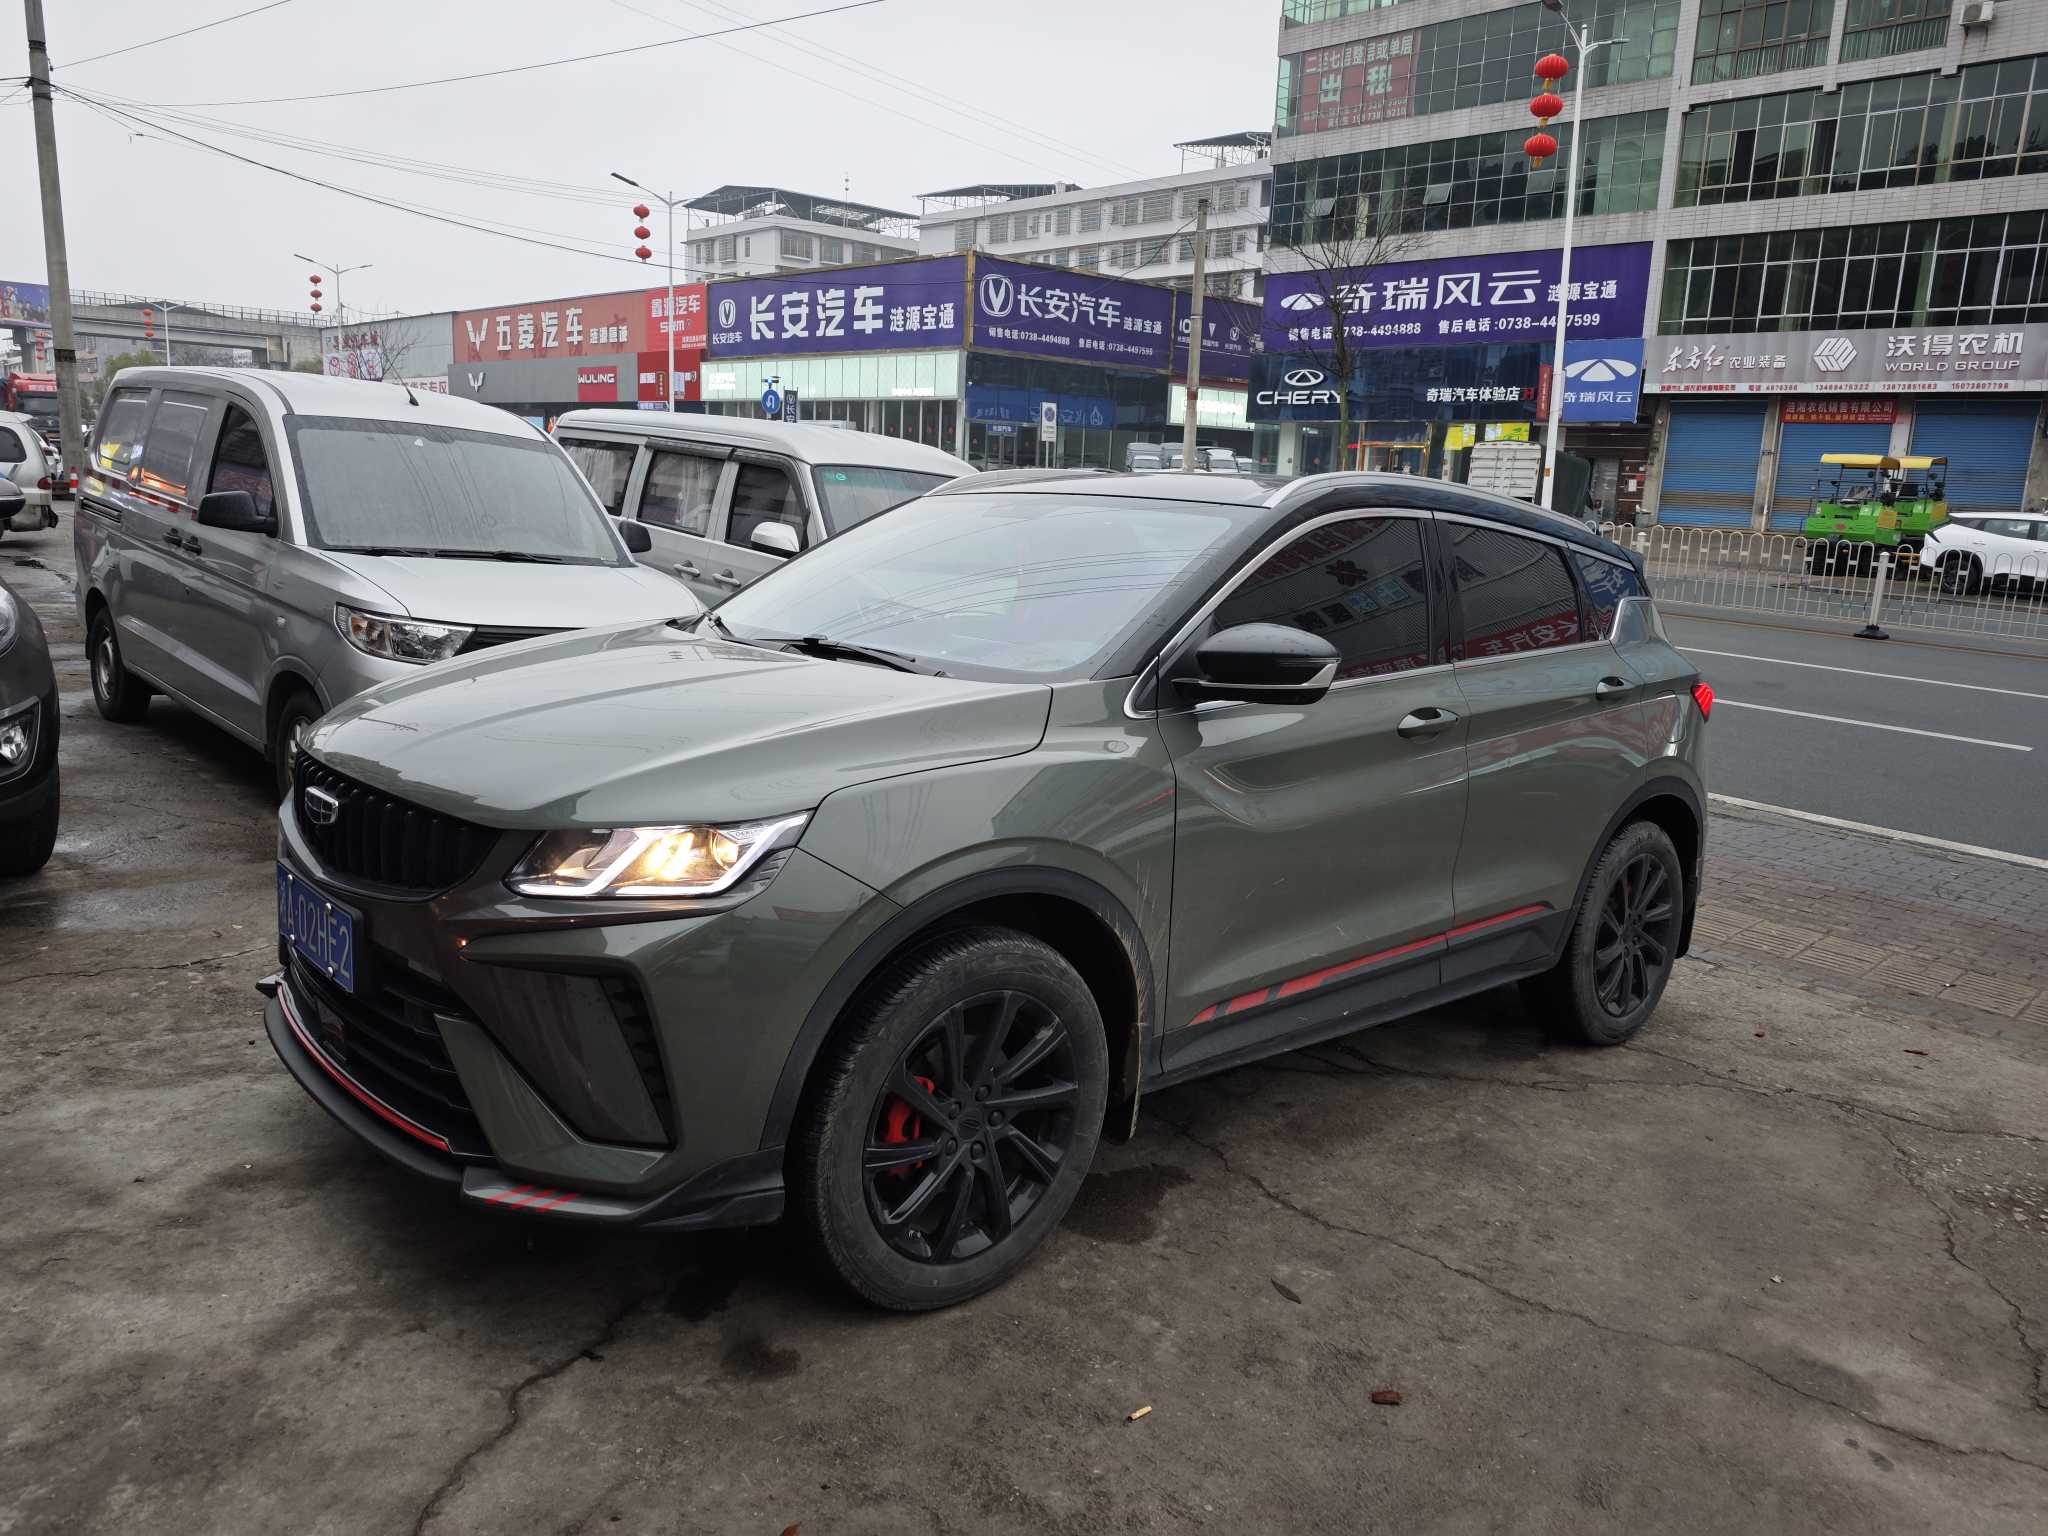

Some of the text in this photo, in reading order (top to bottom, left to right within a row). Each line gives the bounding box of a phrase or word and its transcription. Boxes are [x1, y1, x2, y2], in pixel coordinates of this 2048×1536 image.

[1330, 269, 1542, 314] 奇瑞风云
[749, 285, 955, 341] 长安汽车 涟源宝通
[1018, 283, 1121, 329] 长安汽车
[495, 307, 583, 352] 五菱汽车
[1438, 313, 1601, 335] 售后电话:0738-447599
[712, 331, 743, 345] 长安汽车
[1885, 332, 2025, 357] 沃得农机
[1662, 344, 1787, 373] 东方红 农业装备
[1885, 360, 2020, 372] WORLD GROUP
[577, 373, 616, 384] WULING
[1256, 390, 1341, 405] CHERY
[1426, 386, 1521, 402] 奇瑞汽车体验店
[1564, 391, 1633, 403] 奇瑞风云
